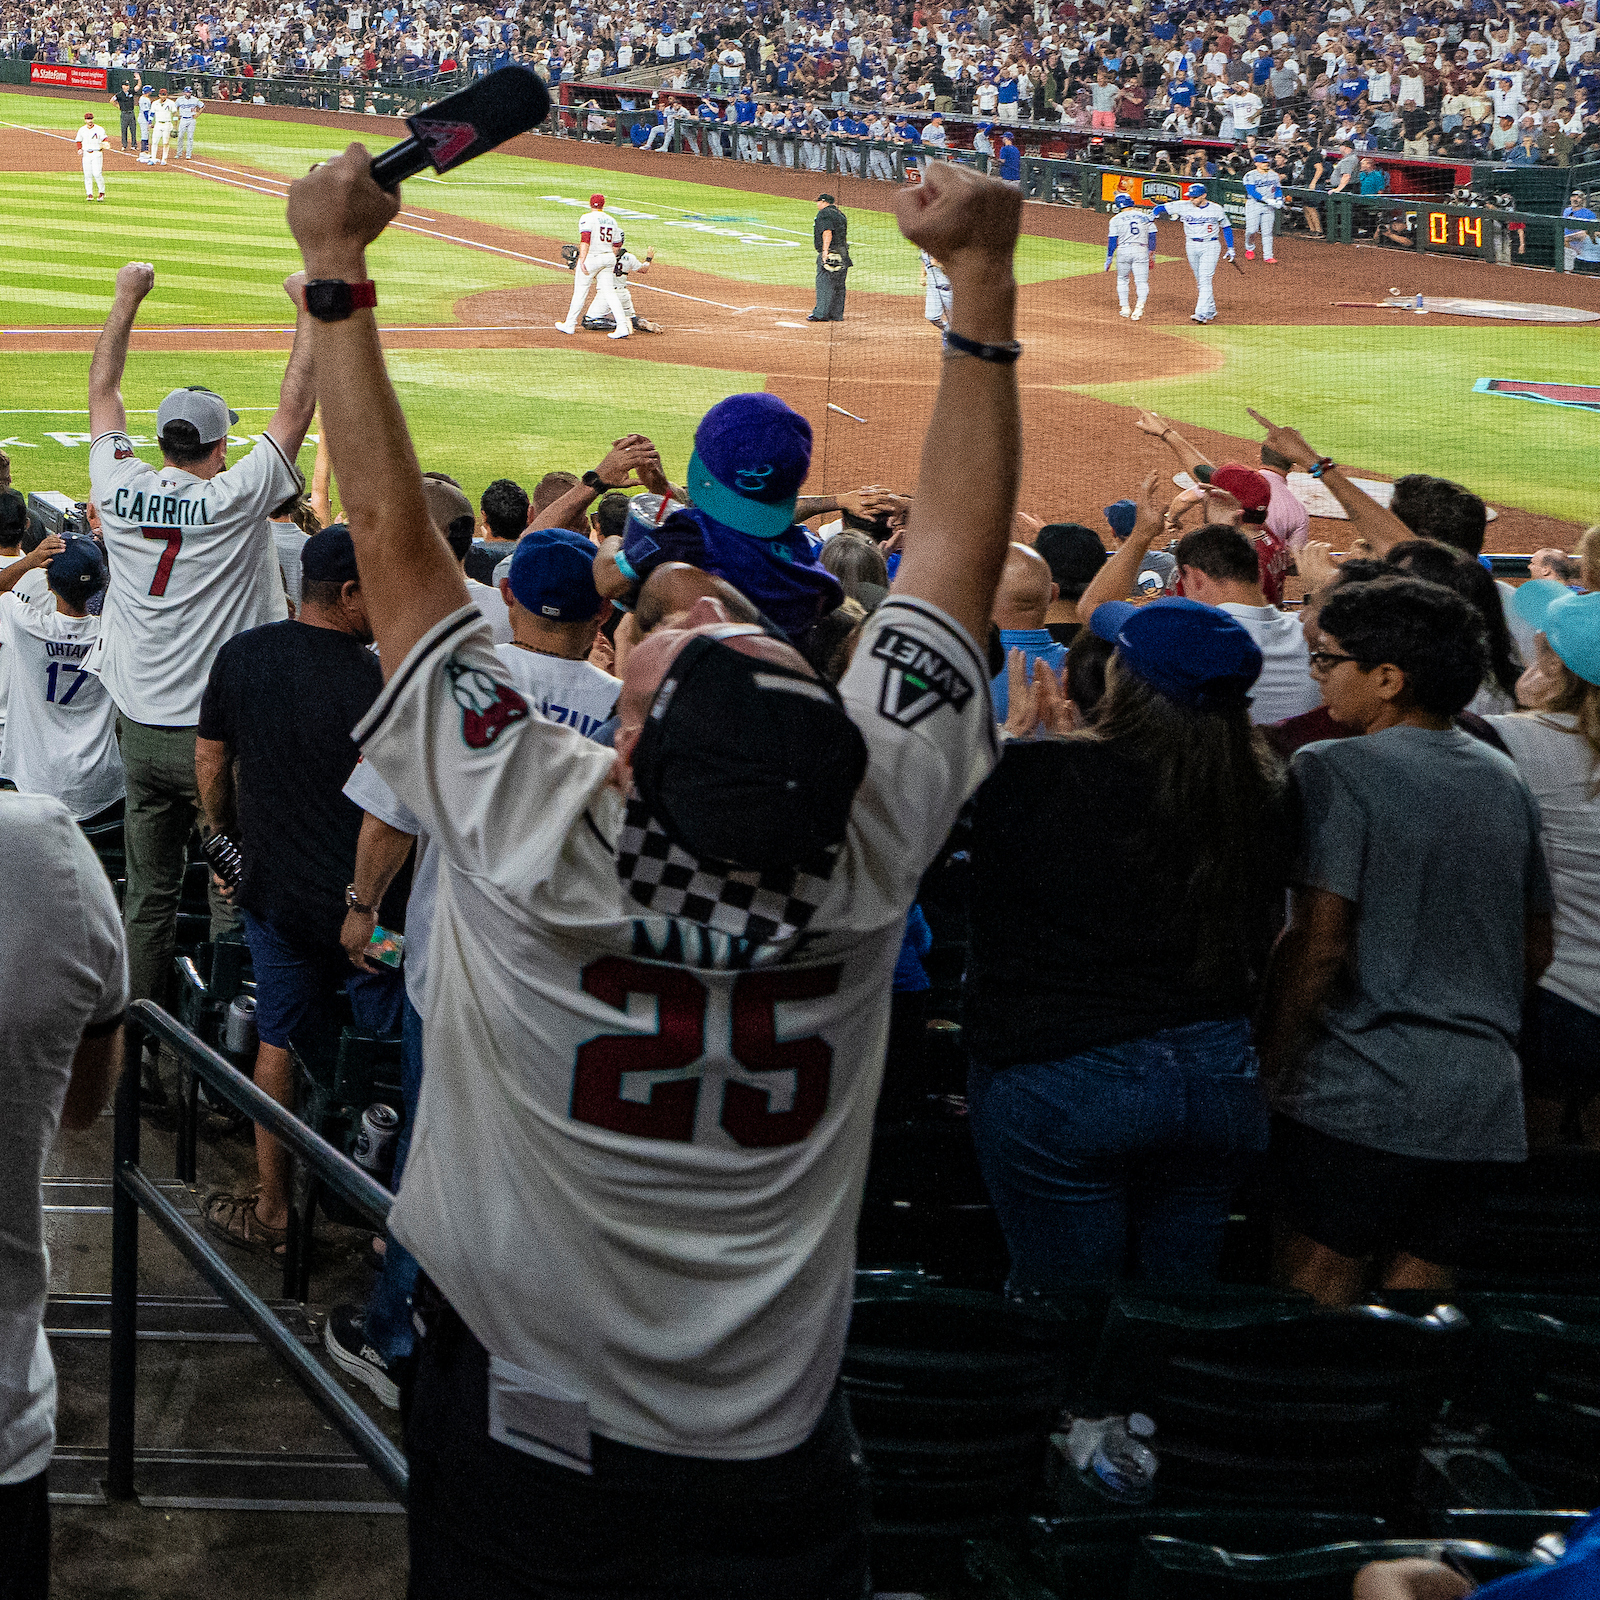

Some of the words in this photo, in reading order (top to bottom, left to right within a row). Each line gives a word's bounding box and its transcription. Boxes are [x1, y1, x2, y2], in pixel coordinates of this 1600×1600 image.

[39, 69, 67, 81] StateFarm
[599, 227, 612, 242] 55
[1129, 221, 1139, 235] 6
[142, 527, 183, 597] 7
[45, 660, 89, 706] 17
[878, 632, 972, 706] AVNET
[569, 955, 845, 1151] 25
